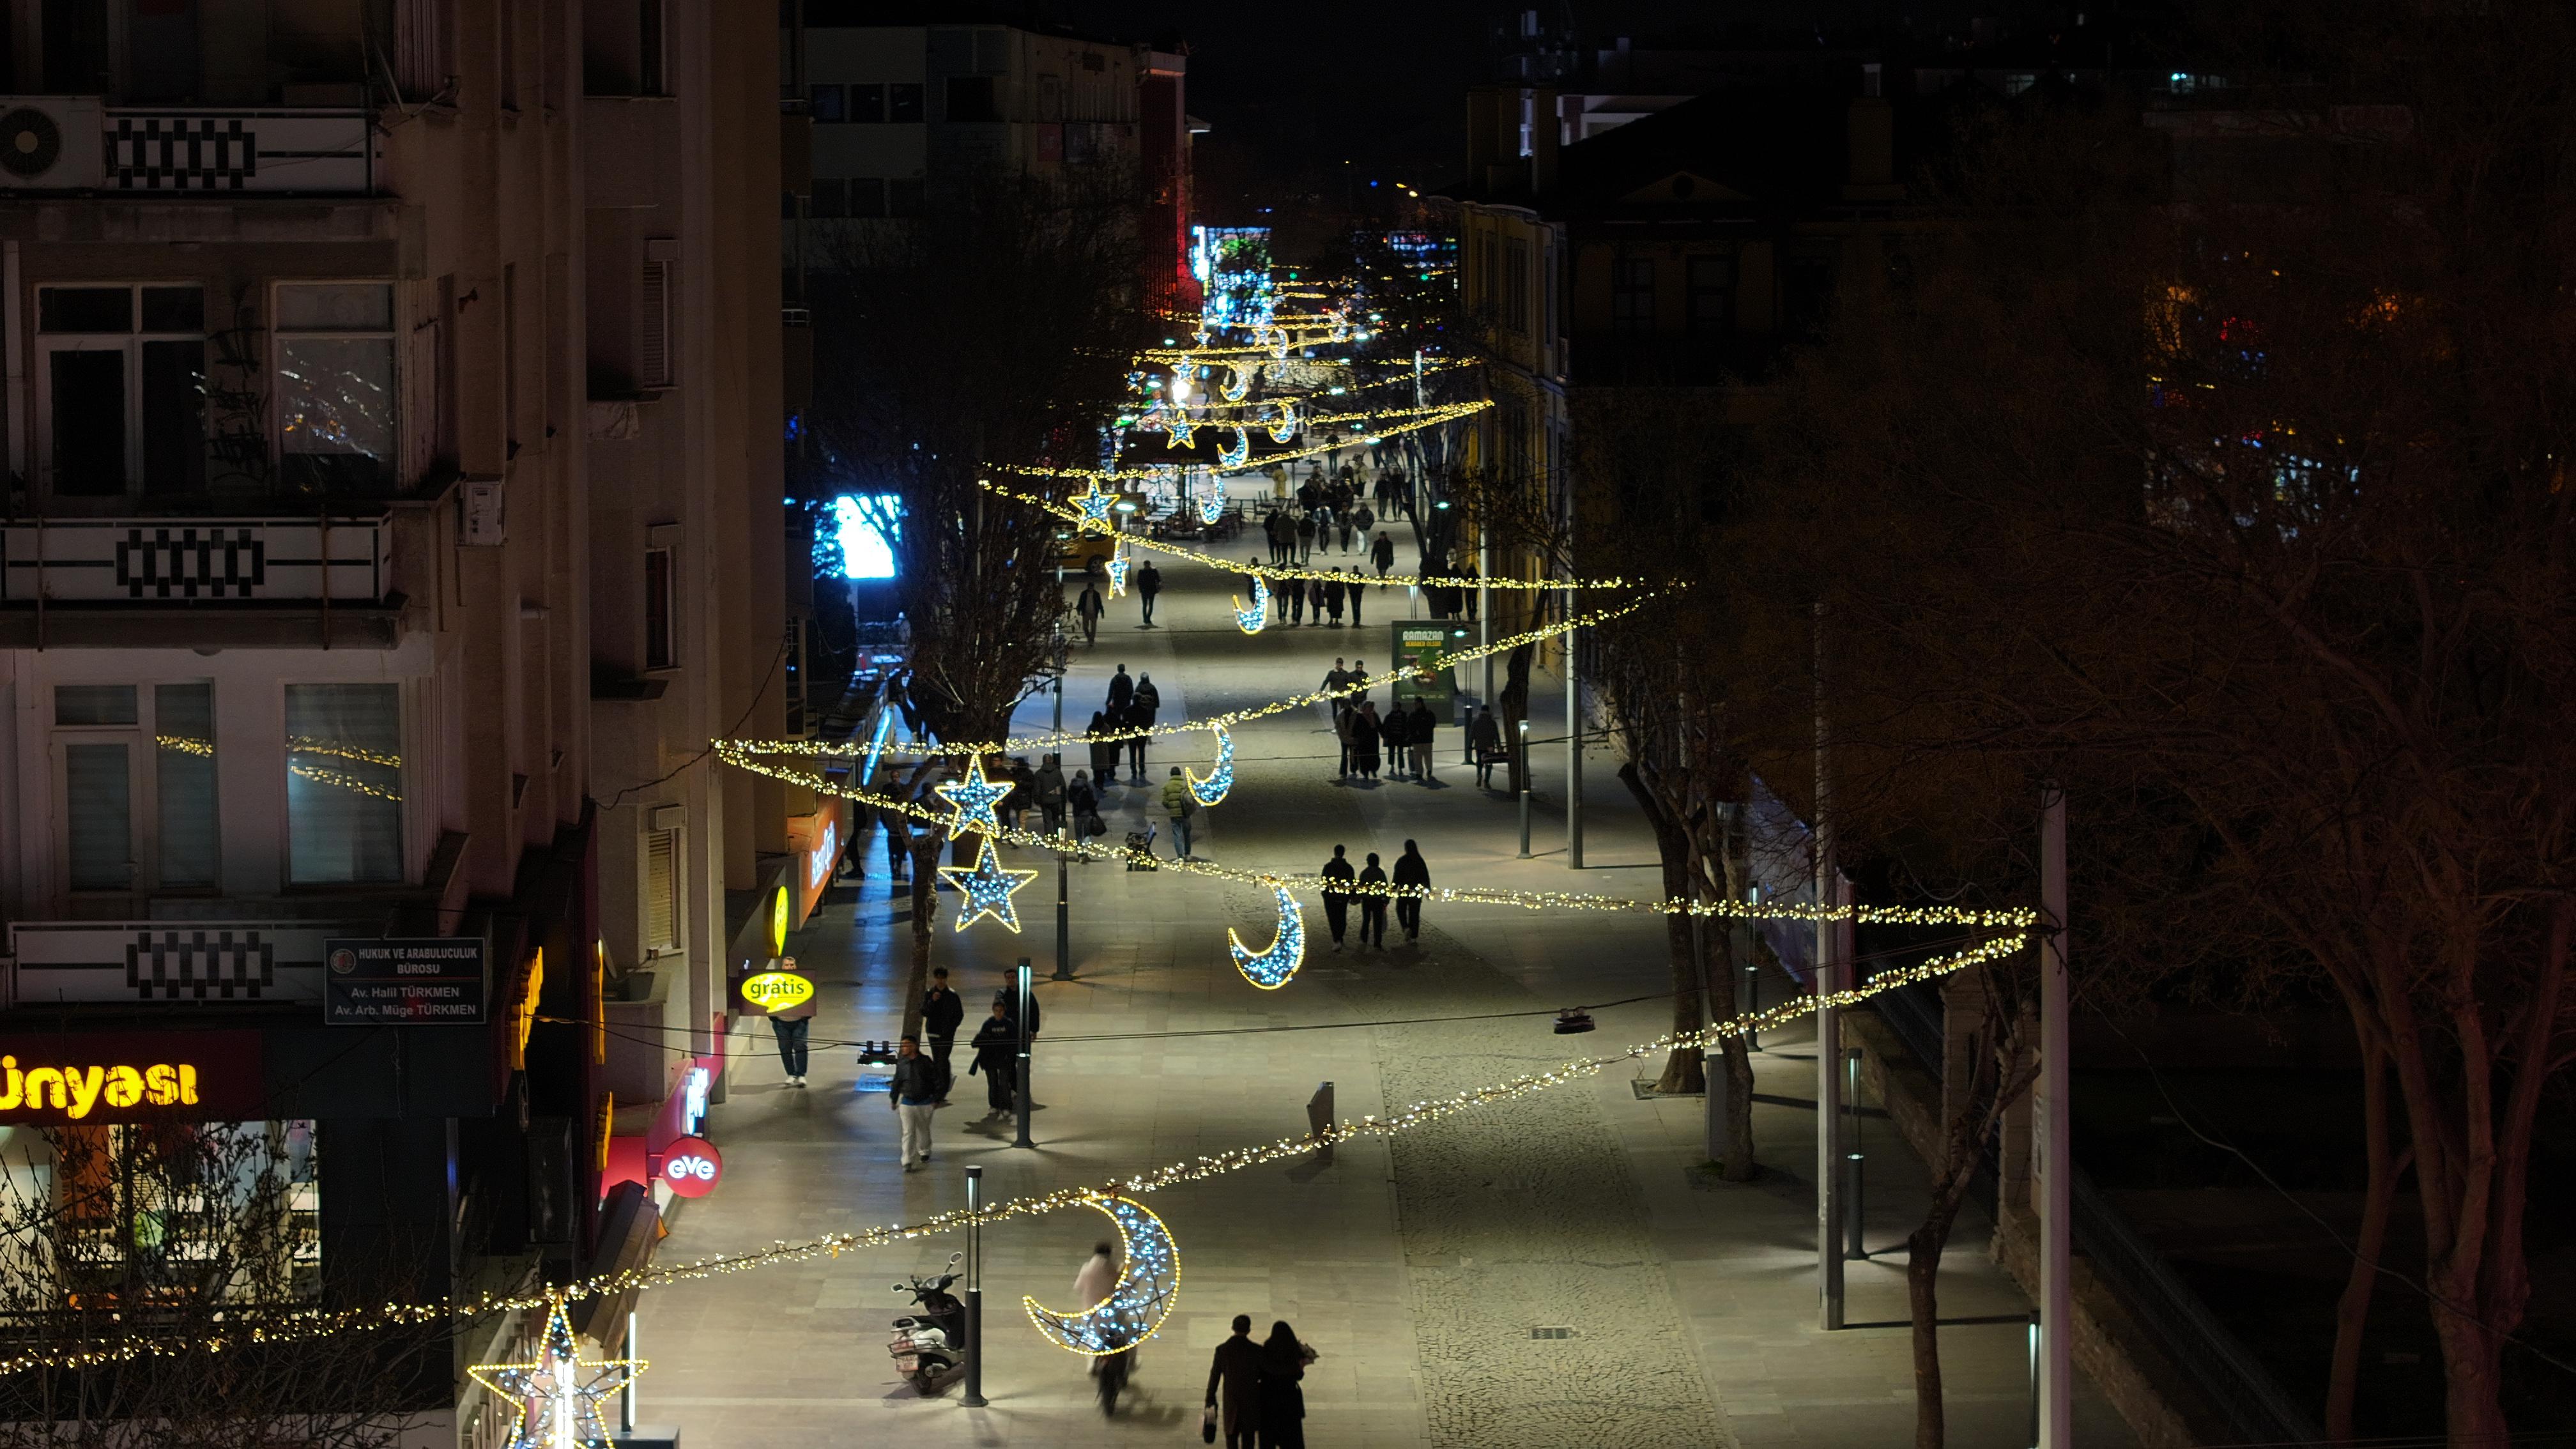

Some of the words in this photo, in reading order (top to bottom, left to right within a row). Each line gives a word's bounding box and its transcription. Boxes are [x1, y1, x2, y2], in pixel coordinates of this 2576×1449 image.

[1402, 631, 1444, 641] RAMAZAN
[358, 948, 391, 959] HUKUK
[393, 948, 405, 959] VE
[406, 947, 478, 959] ARABULUCULUK
[397, 963, 441, 974] BÜROSU
[351, 988, 369, 998] Av.
[371, 988, 397, 998] Halil
[400, 985, 460, 998] TÜRKMEN
[750, 978, 805, 999] gratis
[335, 1005, 352, 1015] Av.
[355, 1005, 379, 1015] Arb.
[382, 1004, 414, 1018] Müge
[416, 1002, 477, 1015] TÜRKMEN
